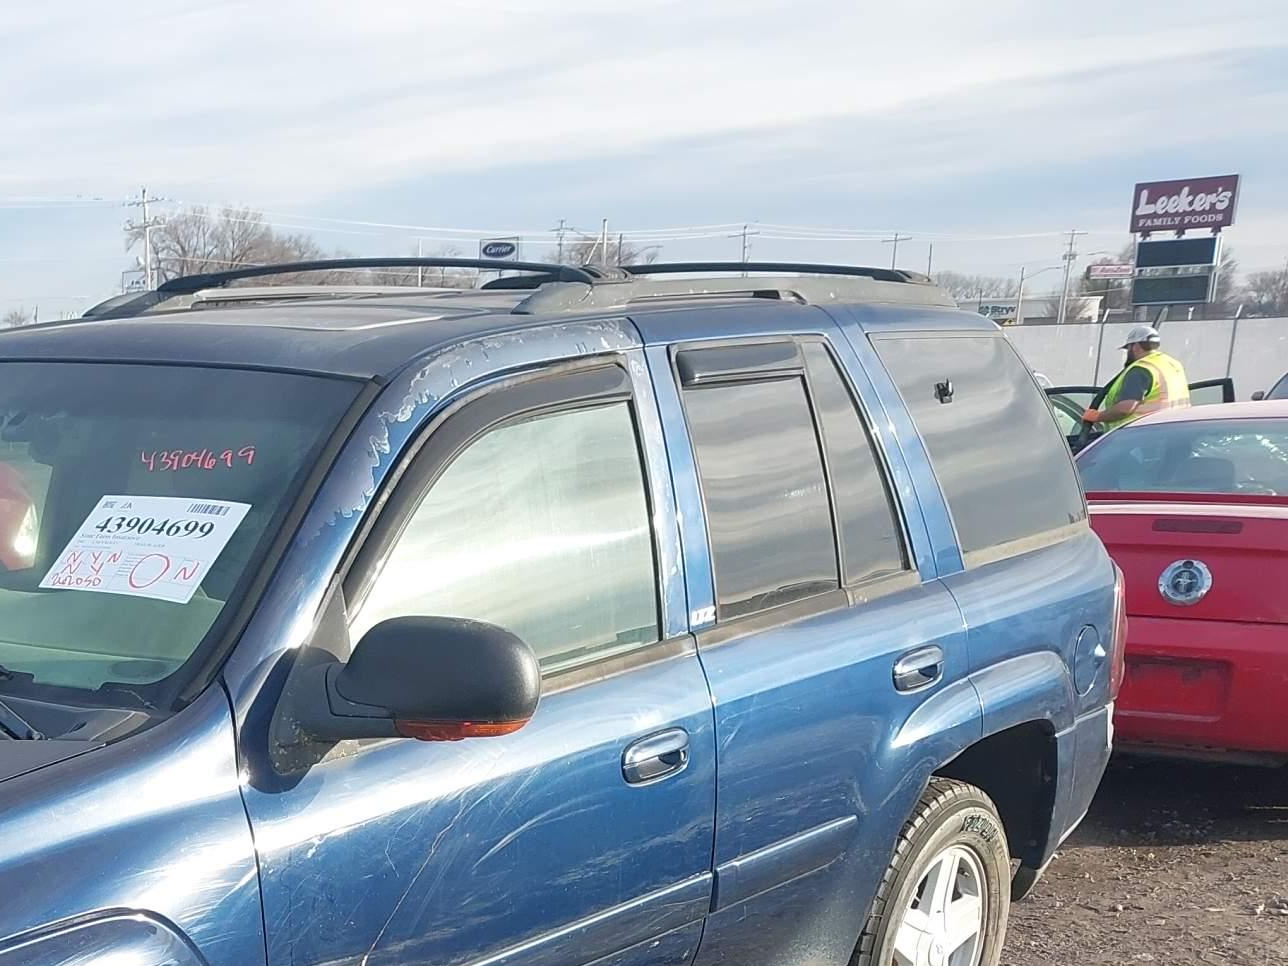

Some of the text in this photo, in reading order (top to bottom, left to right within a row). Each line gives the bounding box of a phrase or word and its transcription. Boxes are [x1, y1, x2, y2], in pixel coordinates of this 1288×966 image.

[1136, 187, 1232, 215] Leeker's
[1138, 213, 1223, 227] FAMILY FOODS
[486, 245, 512, 254] Carrier
[141, 446, 256, 471] 43904699
[95, 516, 214, 539] 43904699
[174, 560, 200, 581] N
